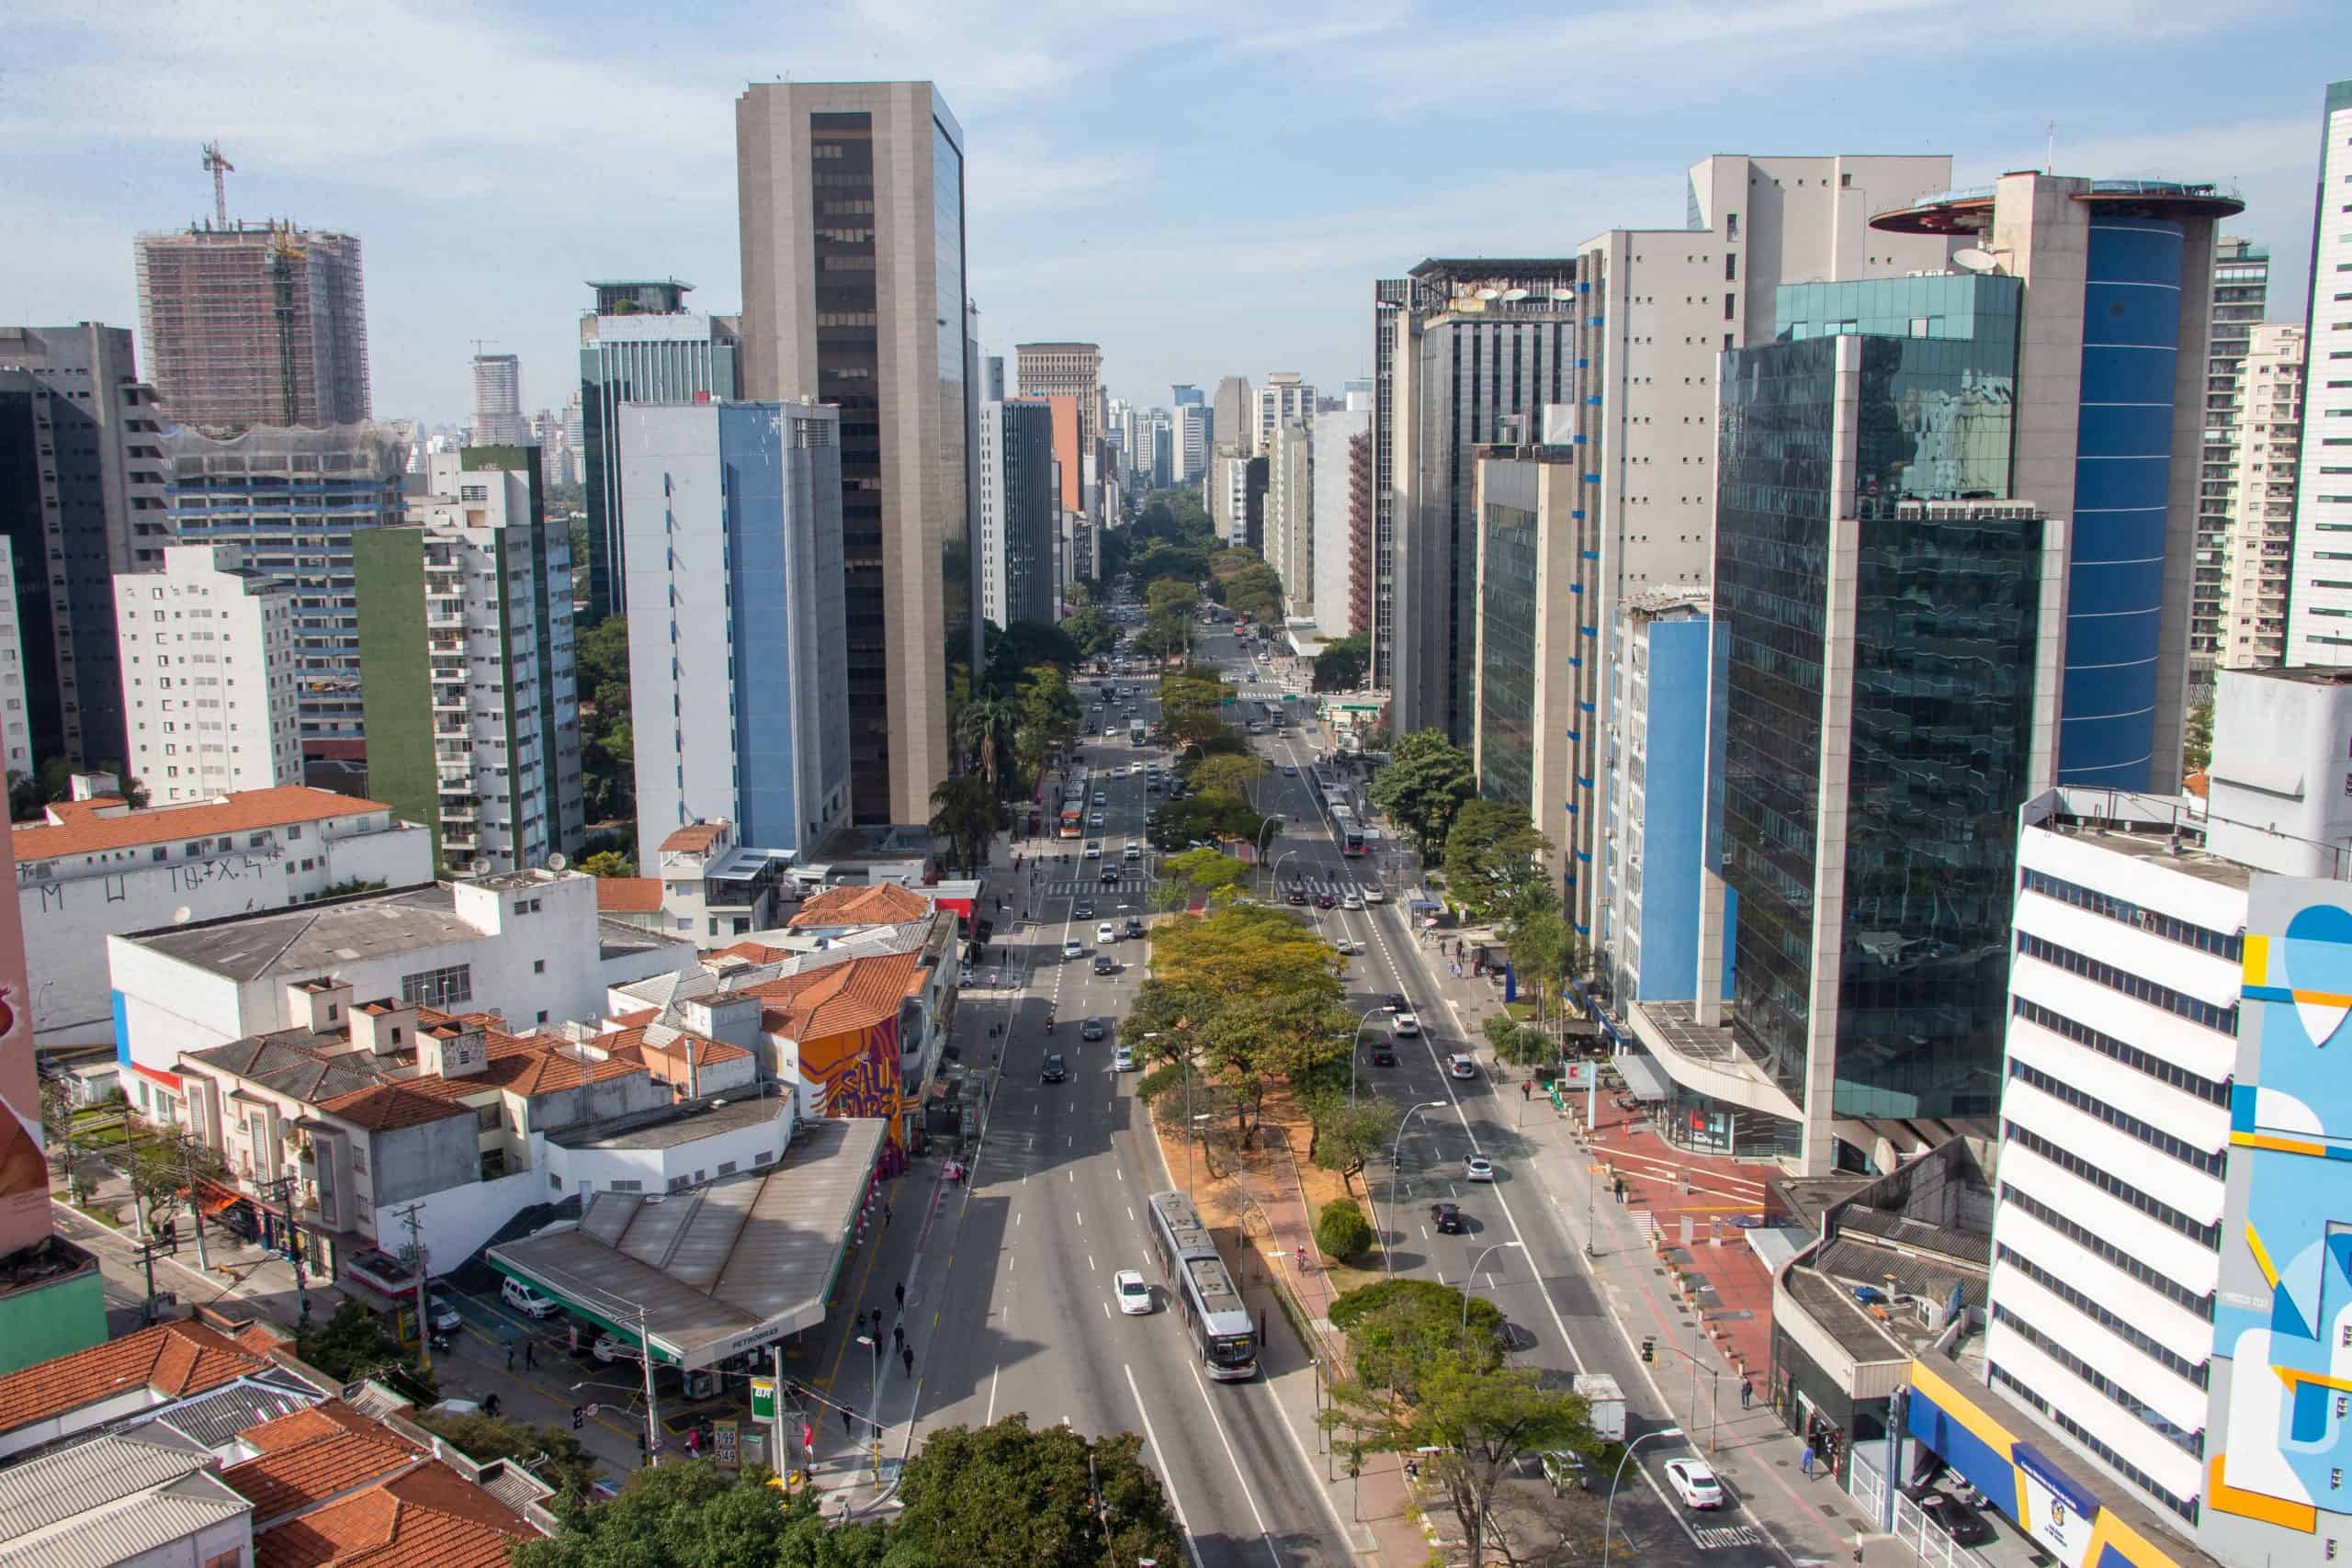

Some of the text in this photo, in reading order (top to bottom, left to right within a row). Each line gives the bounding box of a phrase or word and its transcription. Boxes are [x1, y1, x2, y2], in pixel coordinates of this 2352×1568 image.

[732, 1325, 779, 1349] PETROBRAS
[754, 1388, 772, 1399] BR
[1693, 1523, 1762, 1549] ÔNIBUS
